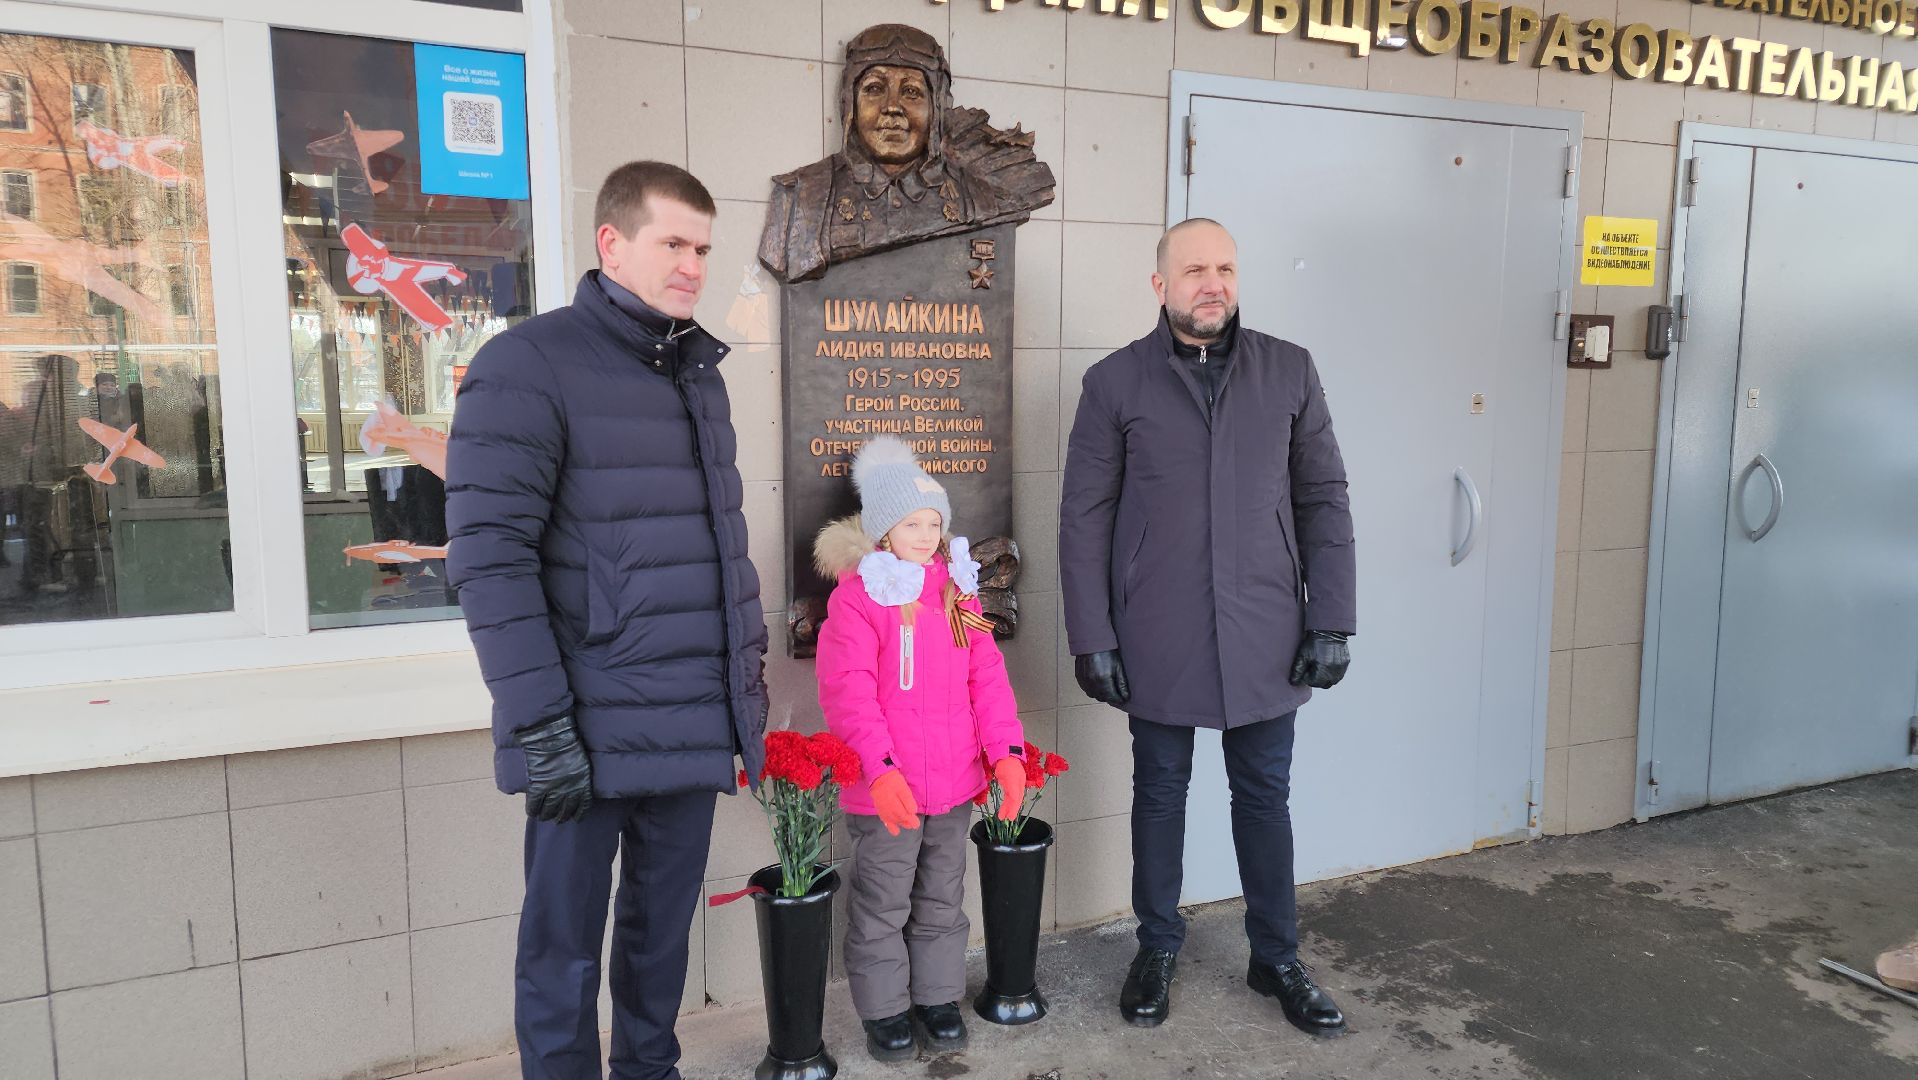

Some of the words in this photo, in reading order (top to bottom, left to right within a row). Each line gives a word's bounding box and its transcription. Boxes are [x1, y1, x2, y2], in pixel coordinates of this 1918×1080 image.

[1602, 232, 1611, 242] НА
[1612, 233, 1639, 244] ОБЪЕКТЕ
[1587, 258, 1651, 270] ВИДЕОНАБЛЮДЕНИЕ
[824, 295, 985, 334] ШУЛАЙКИНА
[815, 340, 885, 361] ЛИДИЯ
[890, 341, 993, 360] ИВАНОВНА
